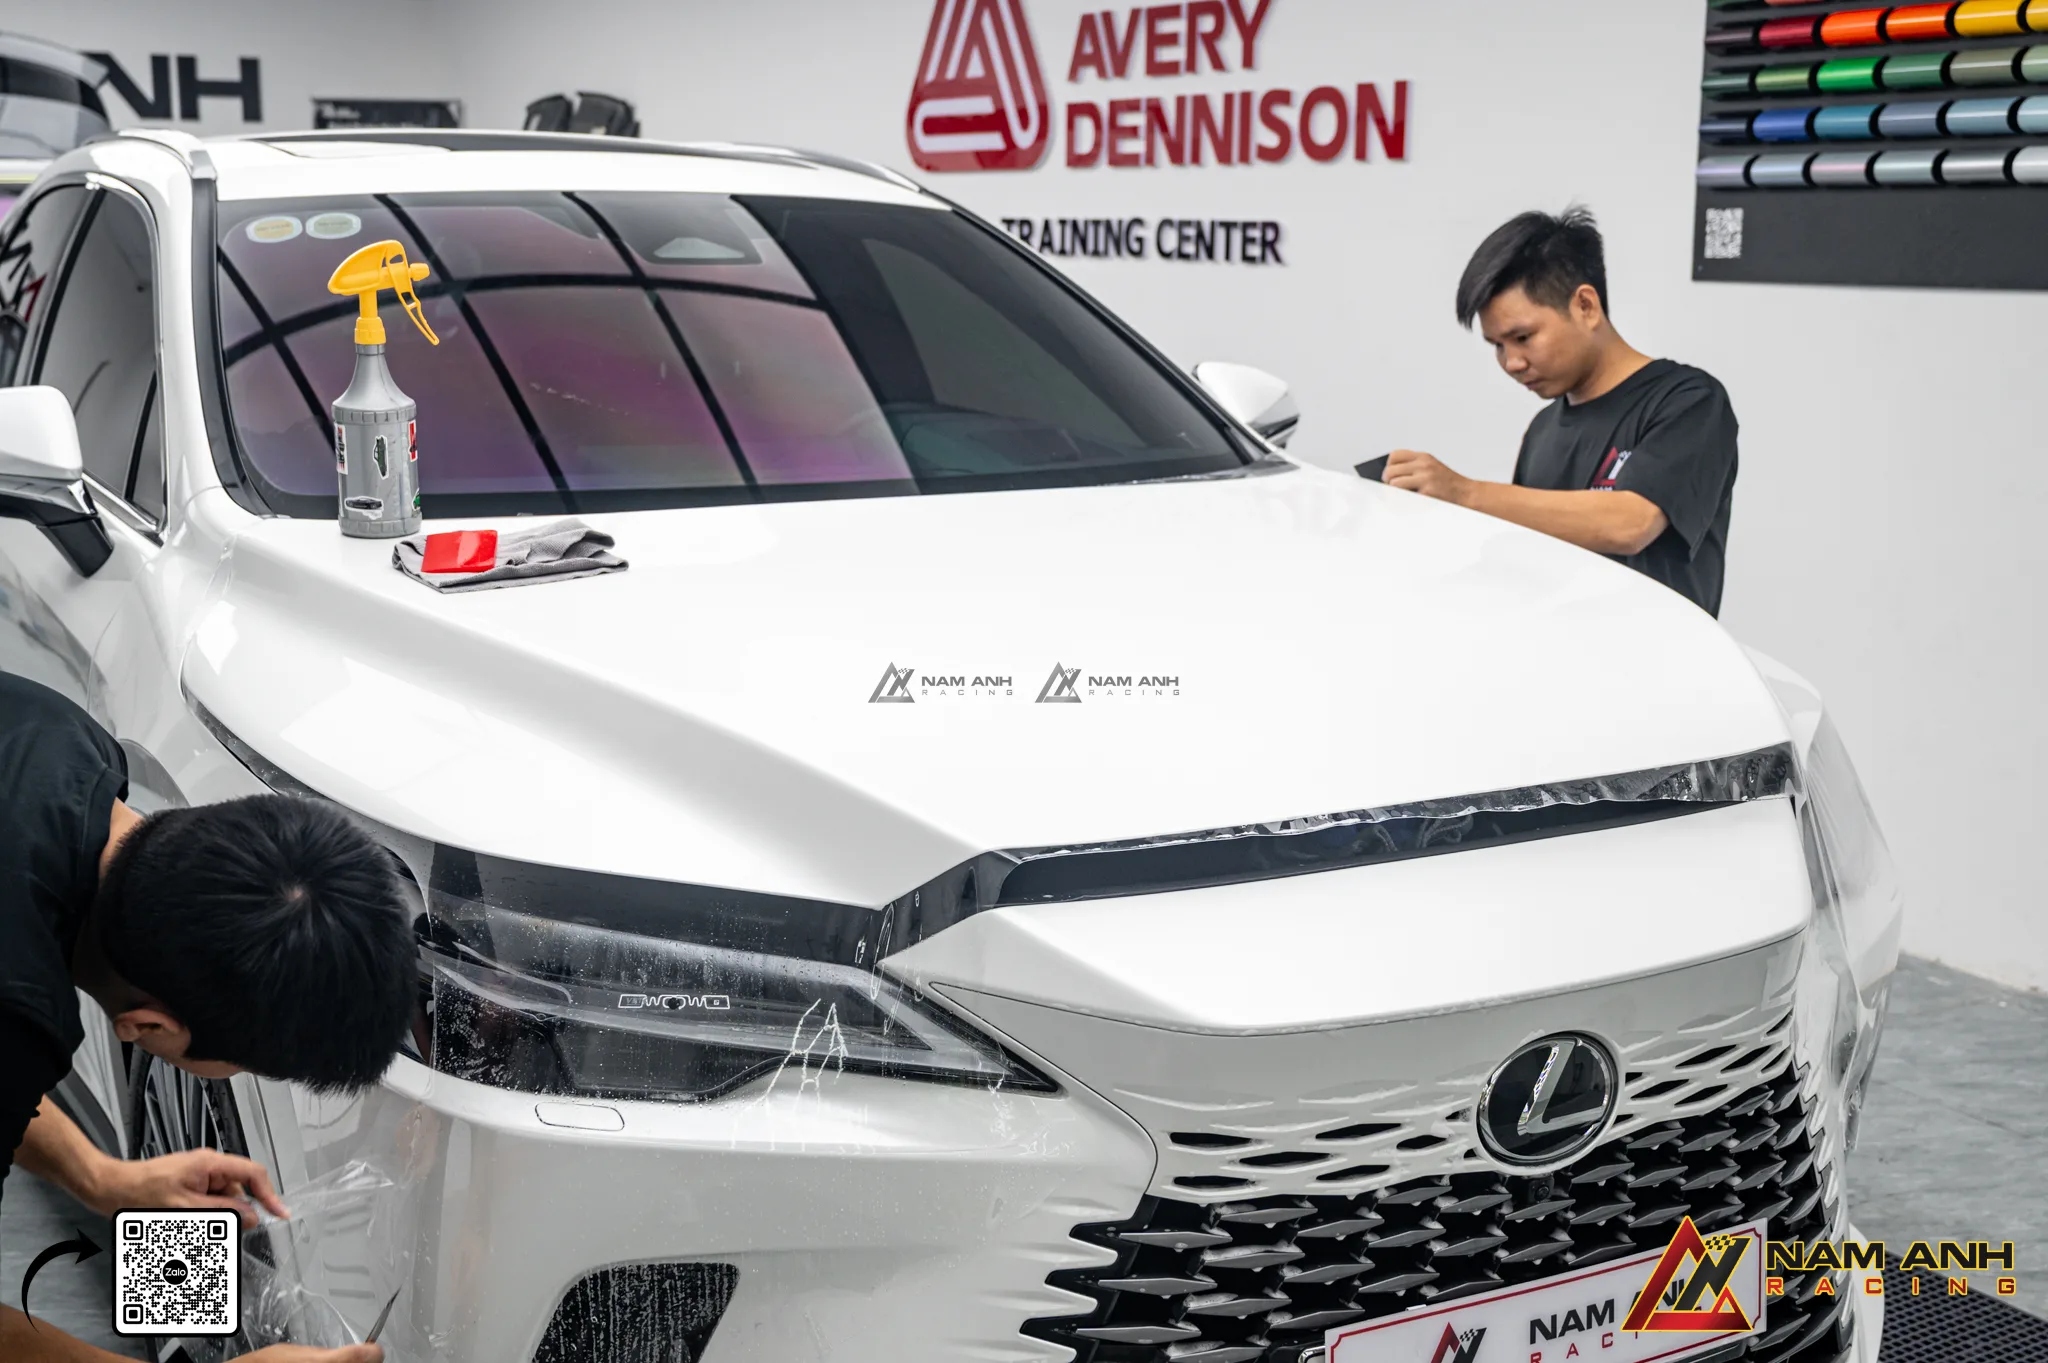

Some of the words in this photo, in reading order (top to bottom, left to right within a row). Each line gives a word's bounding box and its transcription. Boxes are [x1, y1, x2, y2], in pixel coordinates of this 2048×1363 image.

[1067, 0, 1272, 82] AVERY
[1065, 80, 1410, 168] DENNISON
[1156, 218, 1284, 264] CENTER
[1529, 1298, 1615, 1345] NAM
